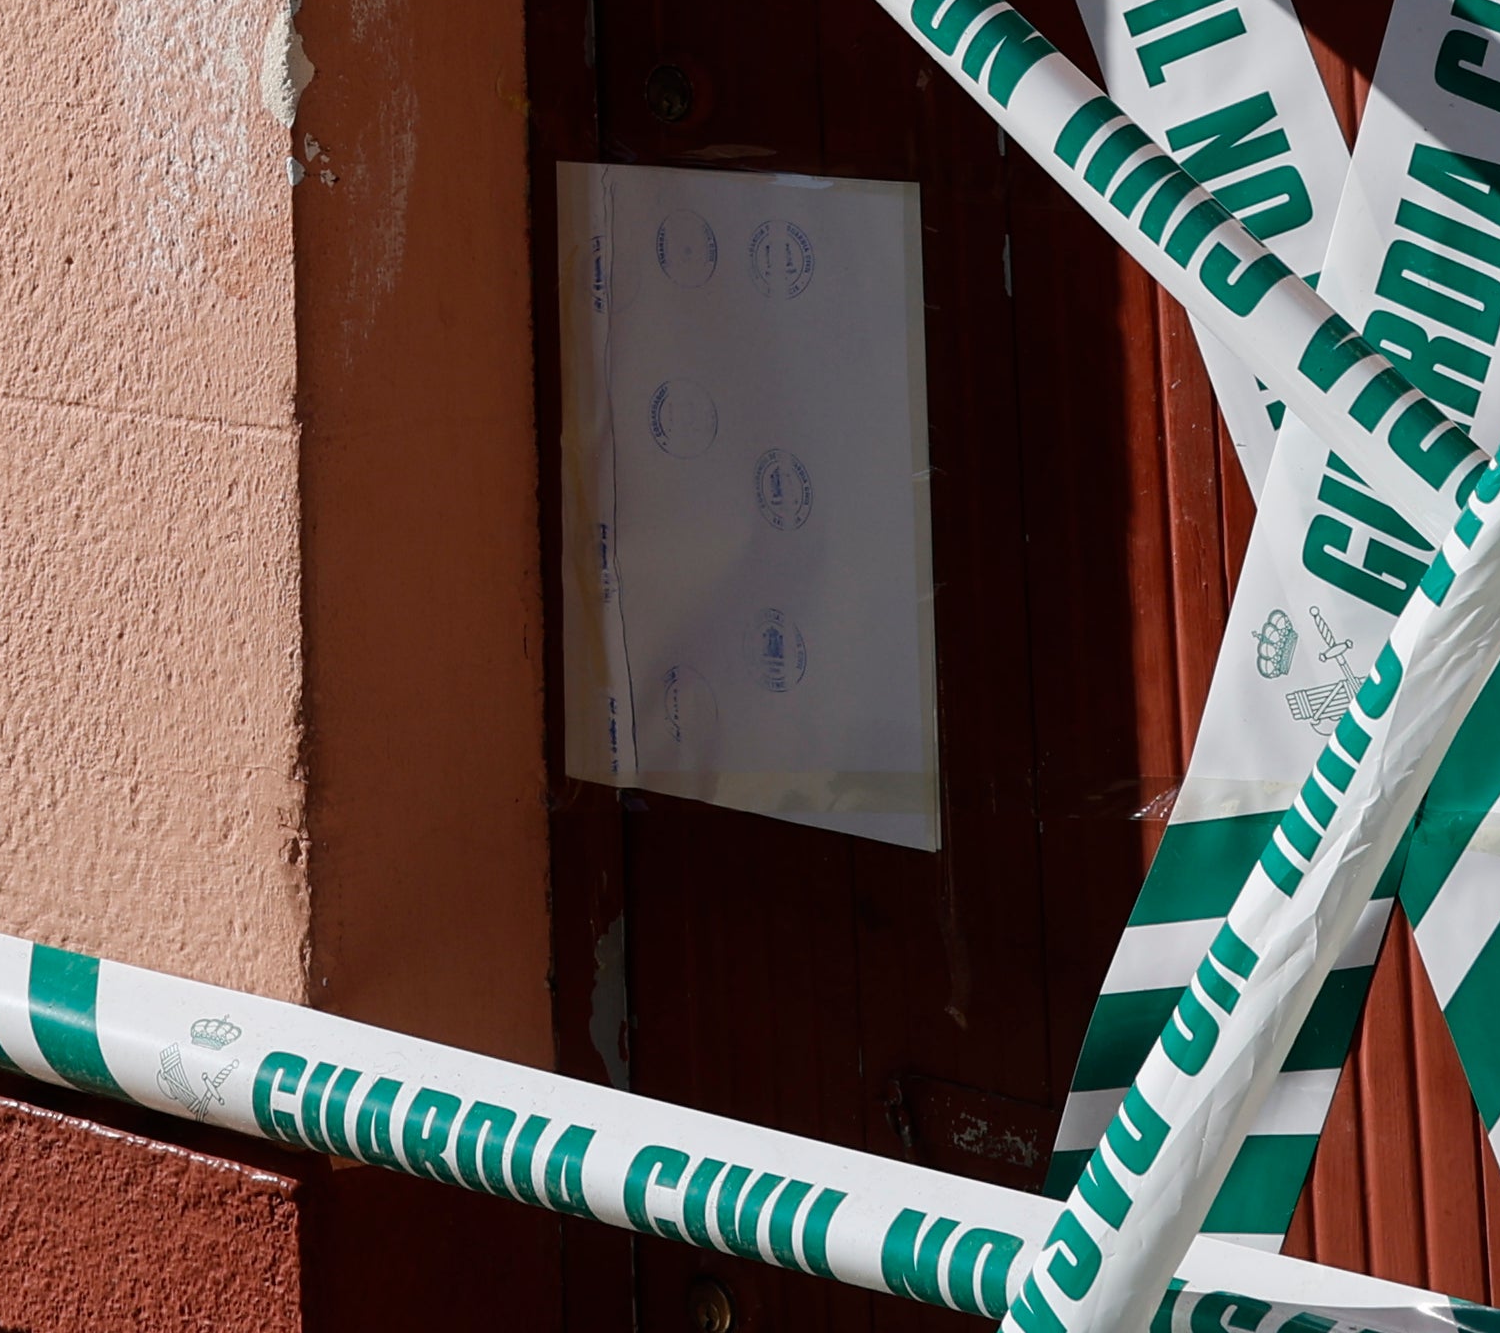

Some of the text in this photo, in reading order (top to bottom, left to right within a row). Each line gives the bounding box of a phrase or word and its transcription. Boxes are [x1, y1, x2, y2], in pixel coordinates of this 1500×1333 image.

[1052, 96, 1298, 317] CIVIL
[1164, 89, 1316, 245] NO
[251, 1050, 600, 1221] GUARDIA
[624, 1143, 848, 1278] CIVIL
[880, 1206, 1026, 1318] NO
